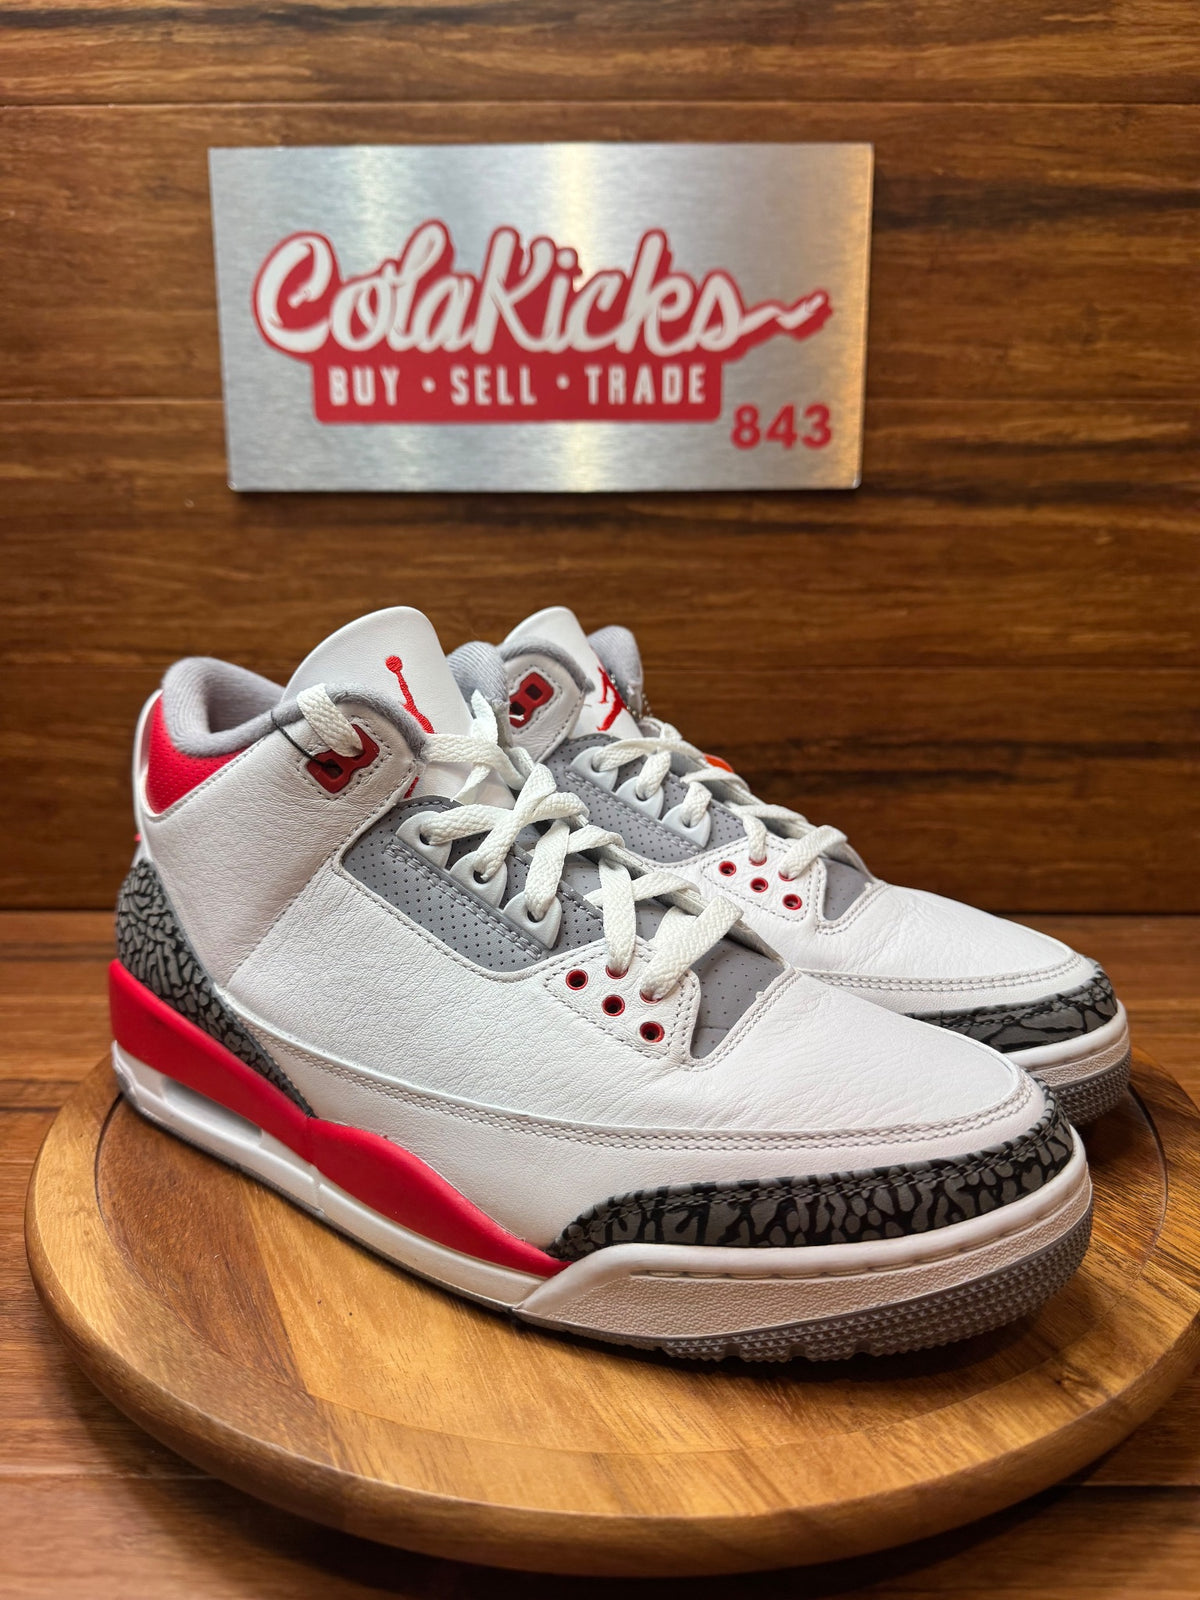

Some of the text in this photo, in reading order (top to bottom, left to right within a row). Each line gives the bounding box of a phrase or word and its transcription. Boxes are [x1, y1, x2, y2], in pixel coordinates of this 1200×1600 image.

[329, 363, 706, 406] BUY SELL TRADE
[731, 404, 833, 450] 843
